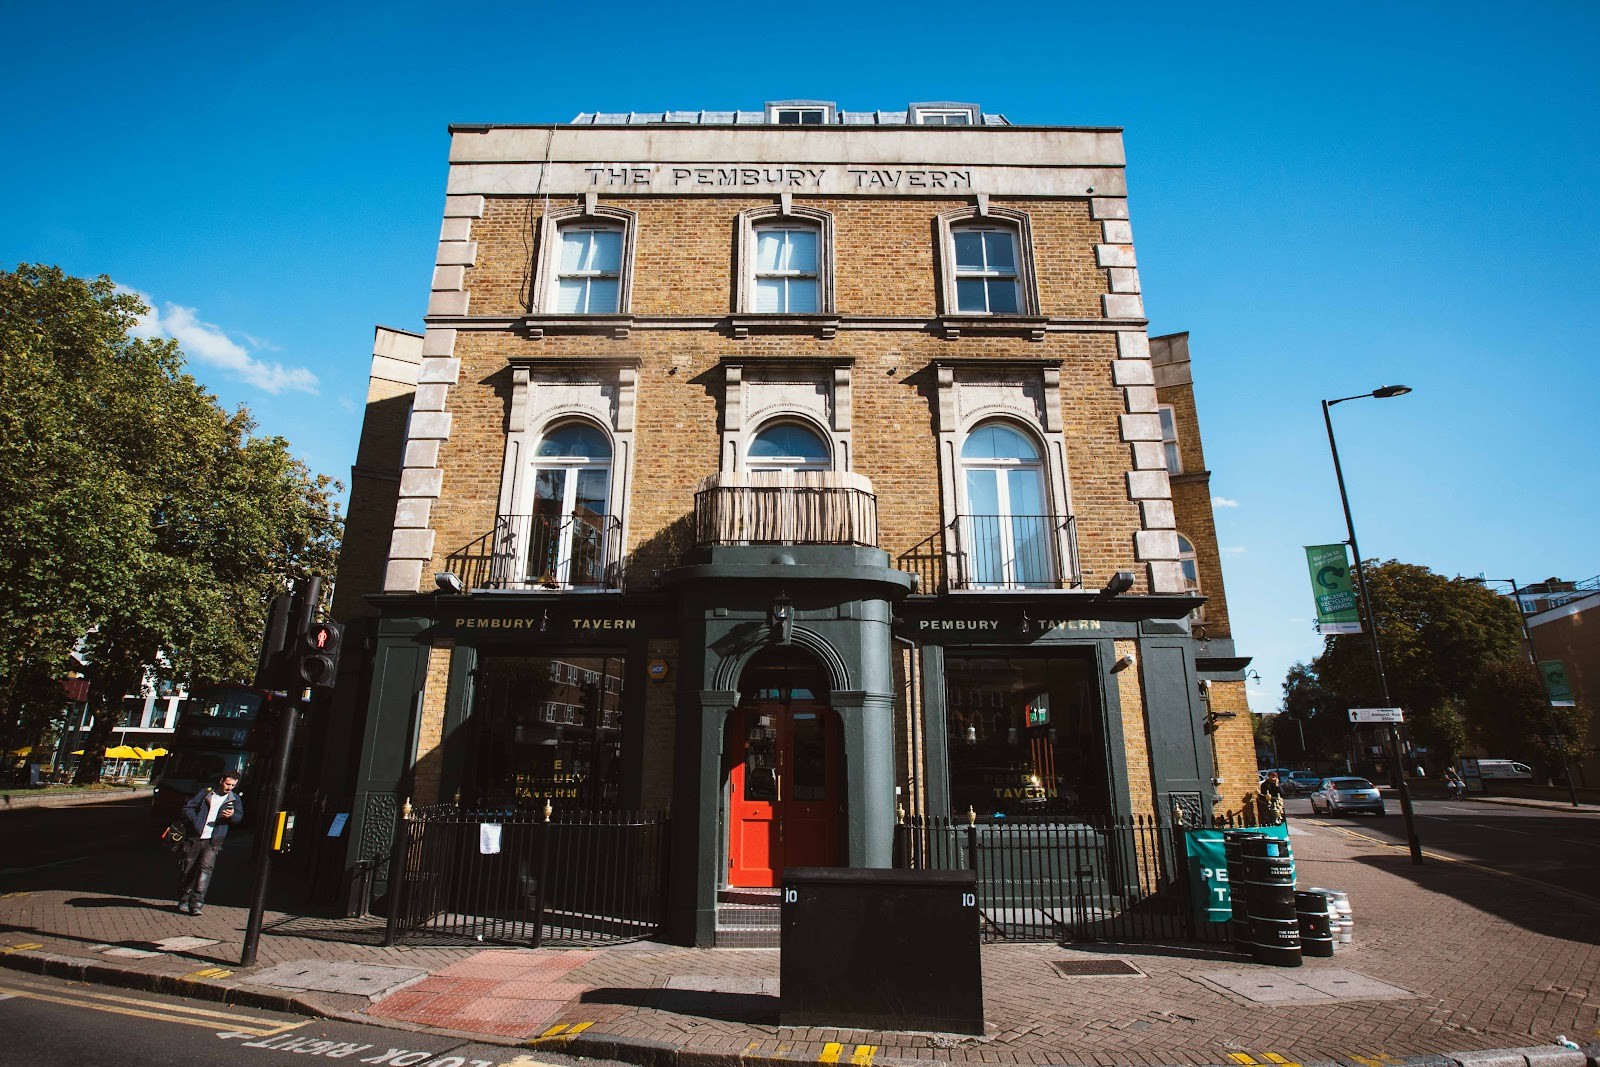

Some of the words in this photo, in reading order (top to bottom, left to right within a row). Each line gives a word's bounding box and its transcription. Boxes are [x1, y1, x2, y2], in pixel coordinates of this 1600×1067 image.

[584, 167, 652, 186] THE
[672, 168, 826, 187] PEMBURY
[847, 169, 972, 189] TAVERN
[1320, 596, 1353, 608] RECYCLING
[1321, 591, 1348, 602] HACKNEY
[1325, 601, 1353, 613] REWARDS
[455, 618, 535, 629] PEMBURY
[573, 619, 636, 629] TAVERN
[919, 620, 999, 630] PEMBURY
[1038, 619, 1101, 630] TAVERN
[993, 787, 1058, 798] TAVERN
[241, 1033, 374, 1059] RIGHT
